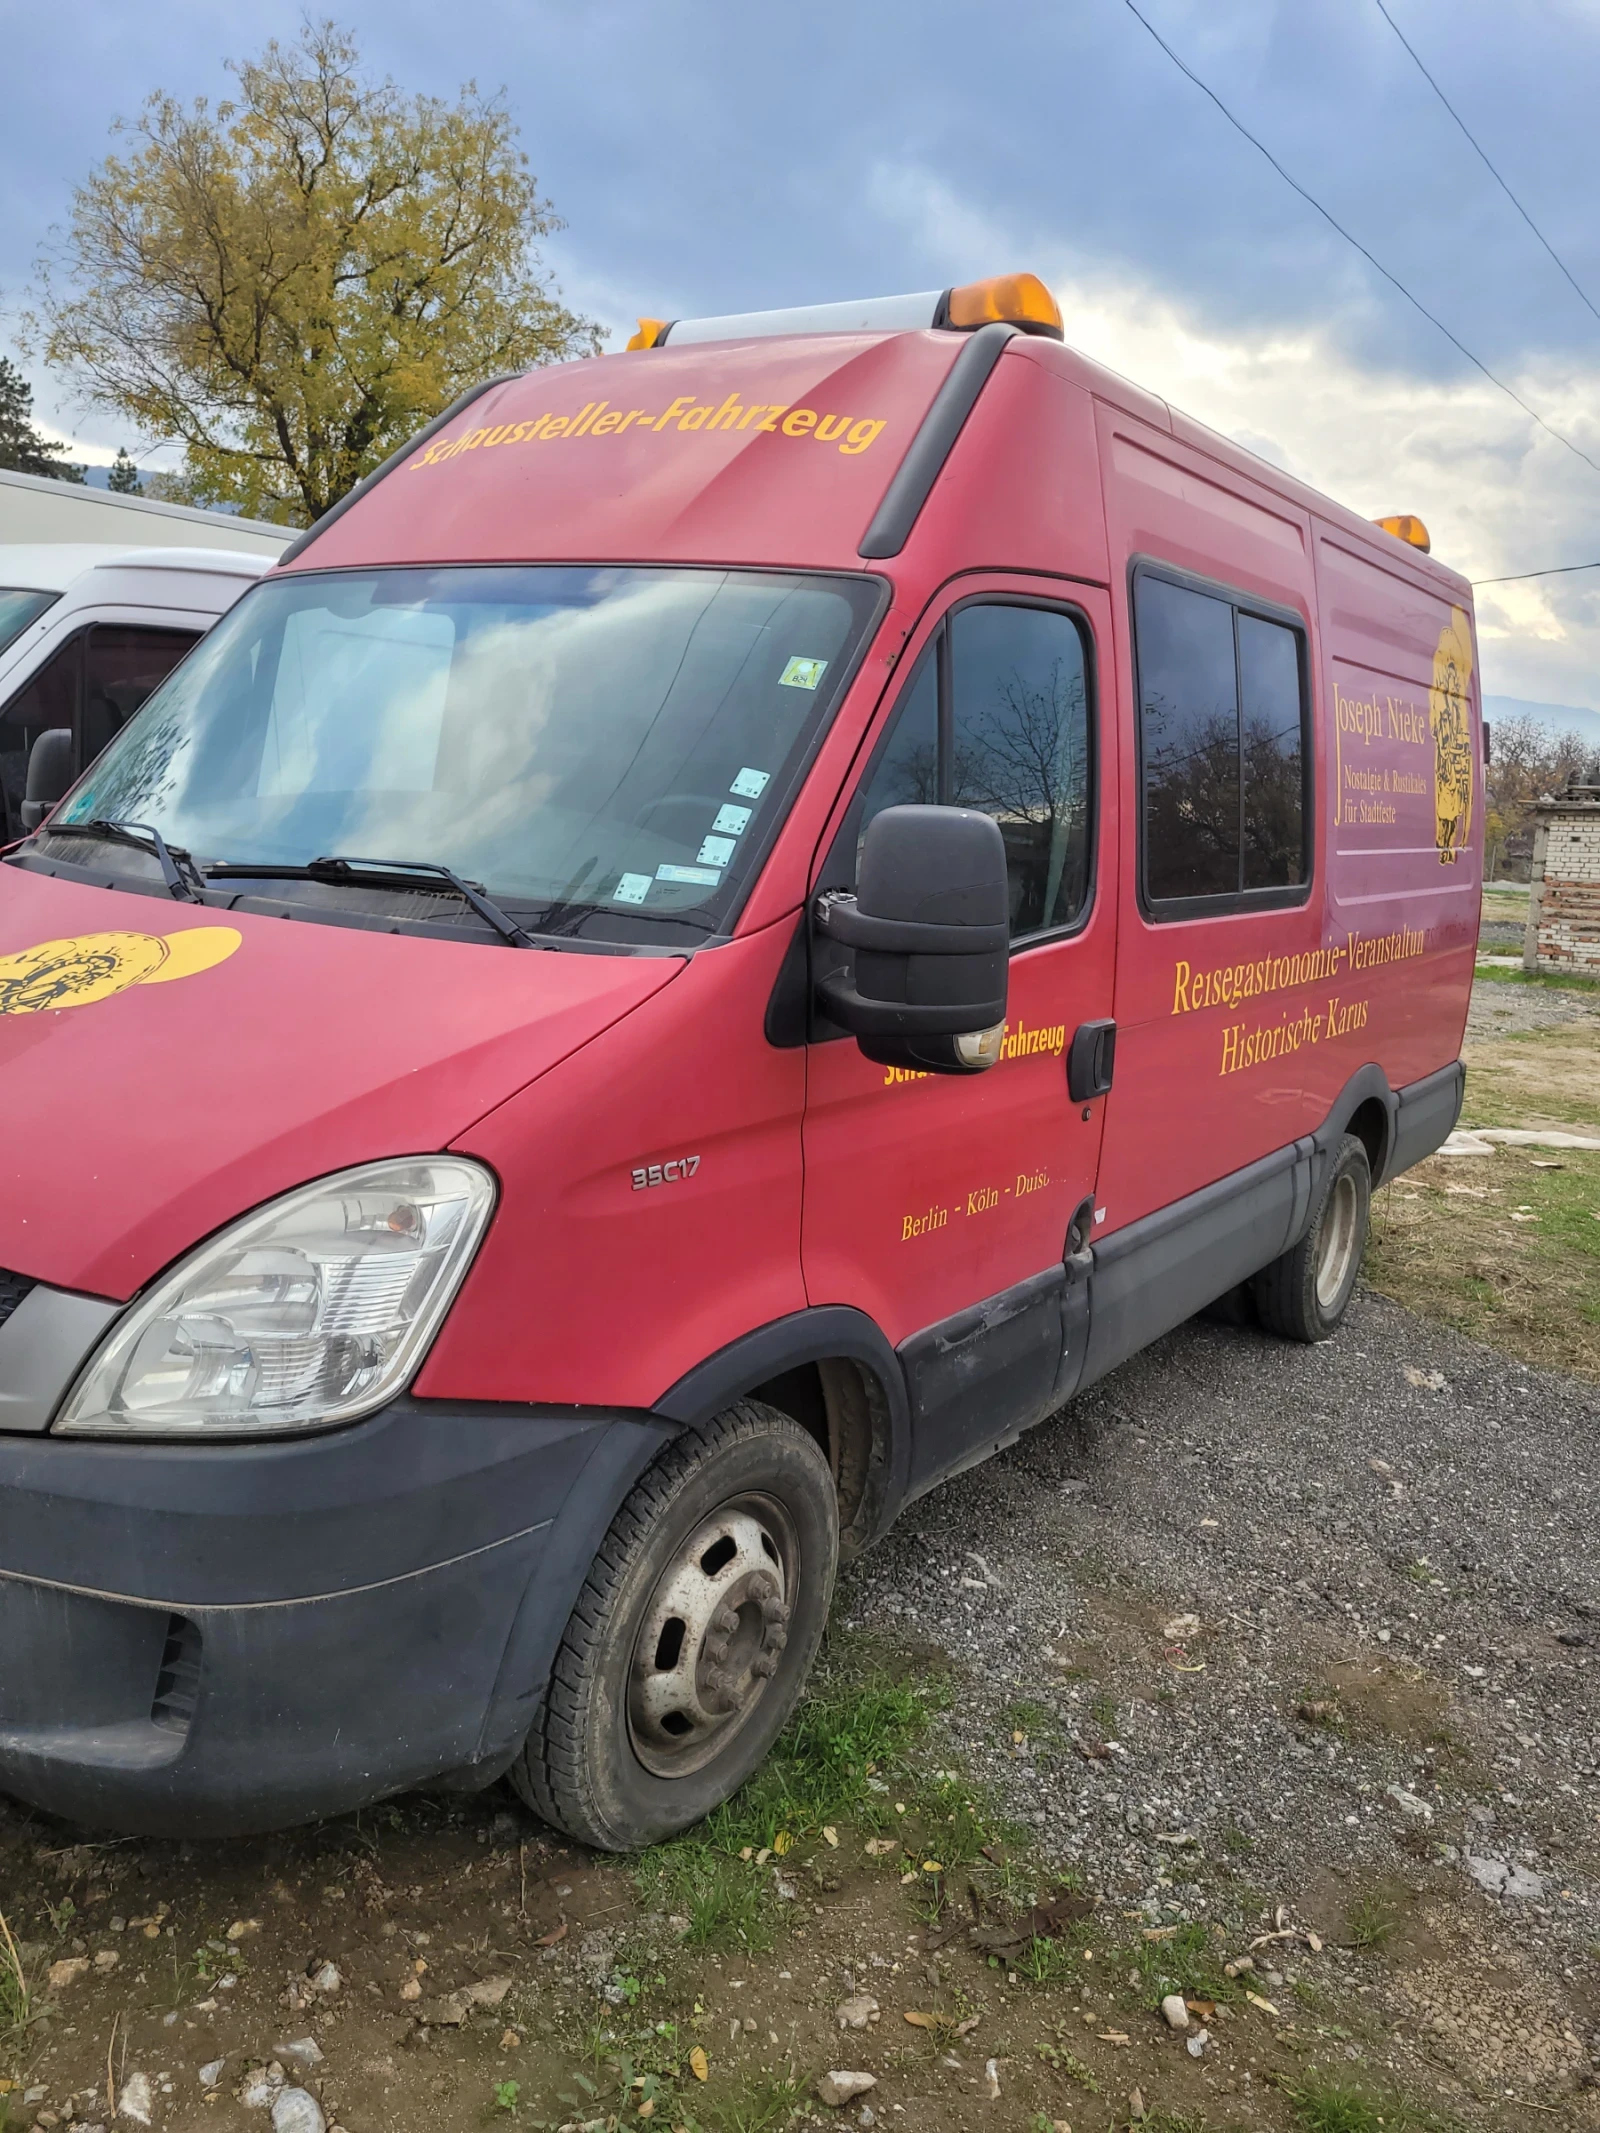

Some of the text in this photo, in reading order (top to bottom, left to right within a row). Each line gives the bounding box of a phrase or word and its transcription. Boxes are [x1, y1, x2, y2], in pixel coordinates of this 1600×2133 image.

[408, 393, 887, 471] Schausteller-Fahrzeug
[1332, 682, 1426, 827] Joseph Nieke
[1344, 764, 1427, 796] Nostalgie & Rustikales
[1344, 798, 1397, 824] für Stadtfeste
[1219, 998, 1369, 1076] Historische Karus
[632, 1155, 701, 1191] 35C17
[901, 1205, 948, 1242] Berlin
[966, 1187, 999, 1217] Köln
